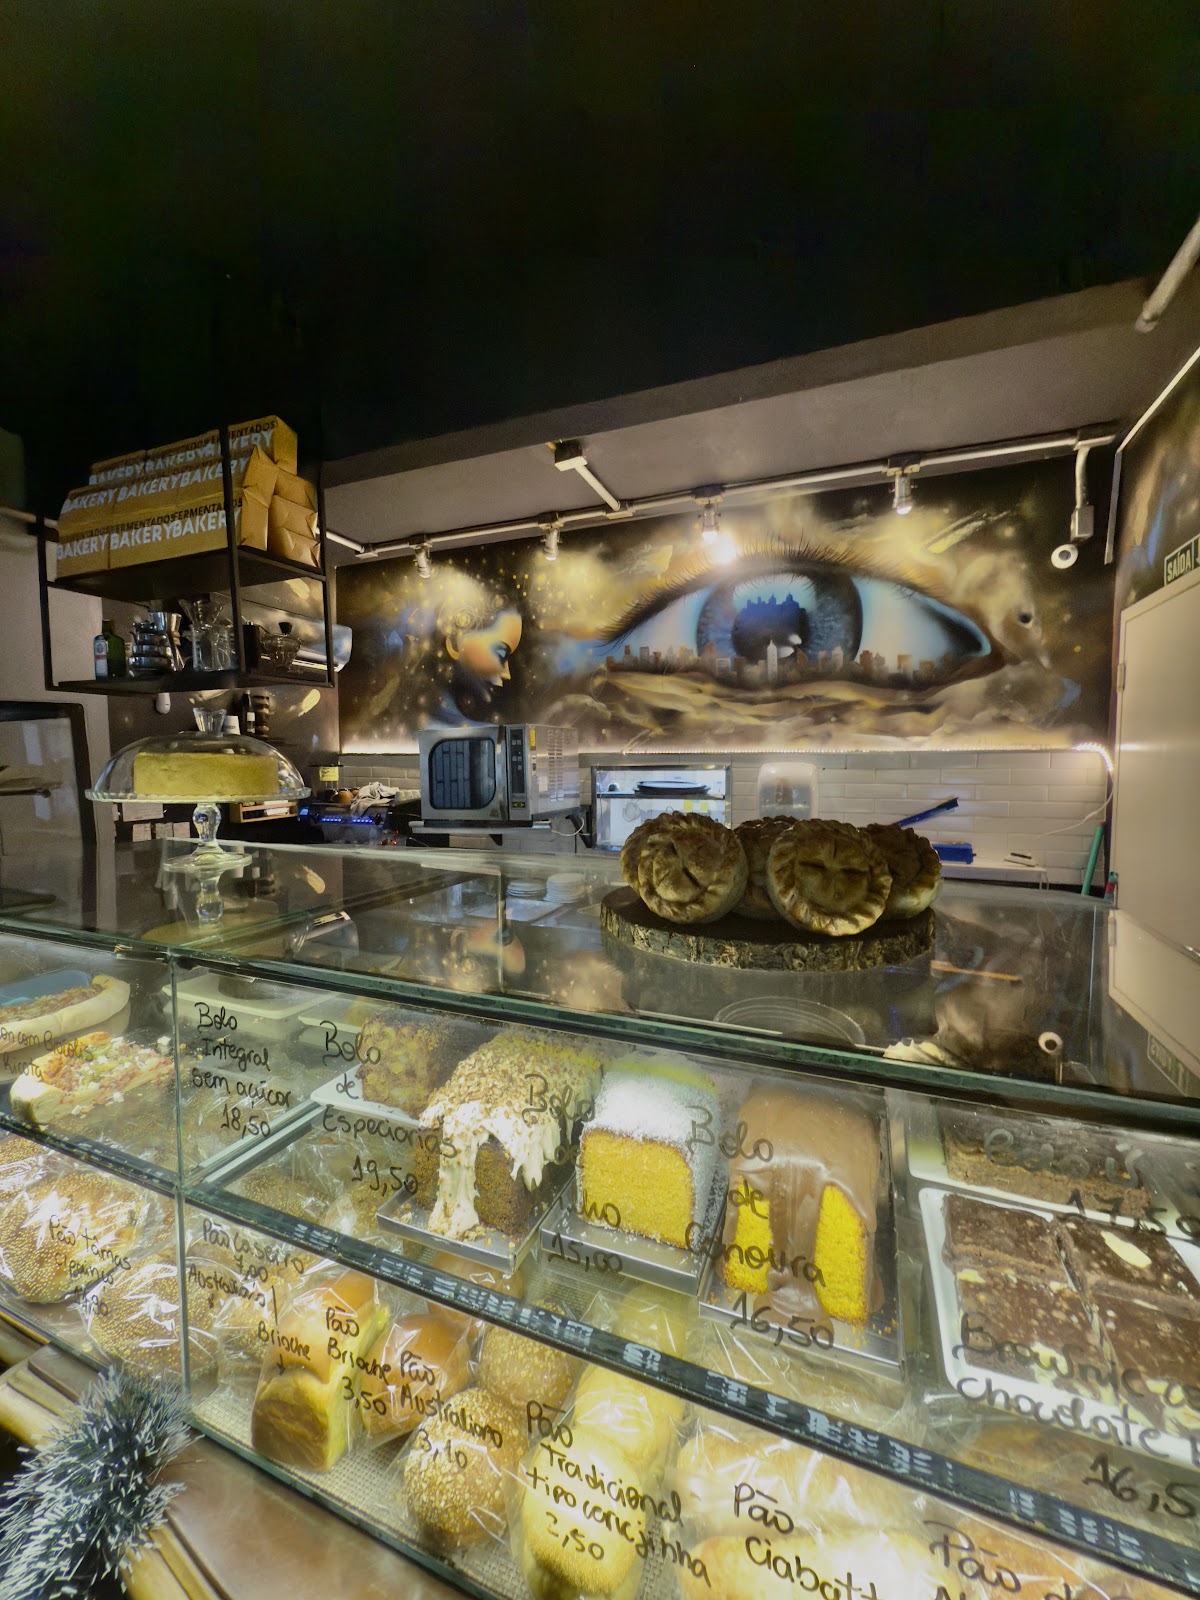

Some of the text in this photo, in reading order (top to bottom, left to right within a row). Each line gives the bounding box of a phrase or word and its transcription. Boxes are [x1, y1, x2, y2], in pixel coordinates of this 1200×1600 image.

[116, 473, 181, 503] BAKERY
[172, 498, 243, 522] FERMENTAOS
[109, 522, 173, 551] BAKERY
[1167, 549, 1192, 582] SAÍDA
[194, 1002, 238, 1034] Bolo
[202, 1038, 271, 1072] Integral
[319, 1020, 381, 1066] Bolo
[522, 1073, 595, 1127] Bolo
[220, 1104, 271, 1139] 18,50
[685, 1105, 774, 1162] Bolo
[351, 1155, 420, 1198] 19,50
[547, 1232, 623, 1273] 15,00
[326, 1306, 360, 1338] Pão
[729, 1291, 835, 1350] 16,50
[342, 1376, 387, 1416] 3,50
[527, 1400, 573, 1449] Pão
[733, 1482, 794, 1535] Pão
[923, 1520, 1021, 1593] Pão
